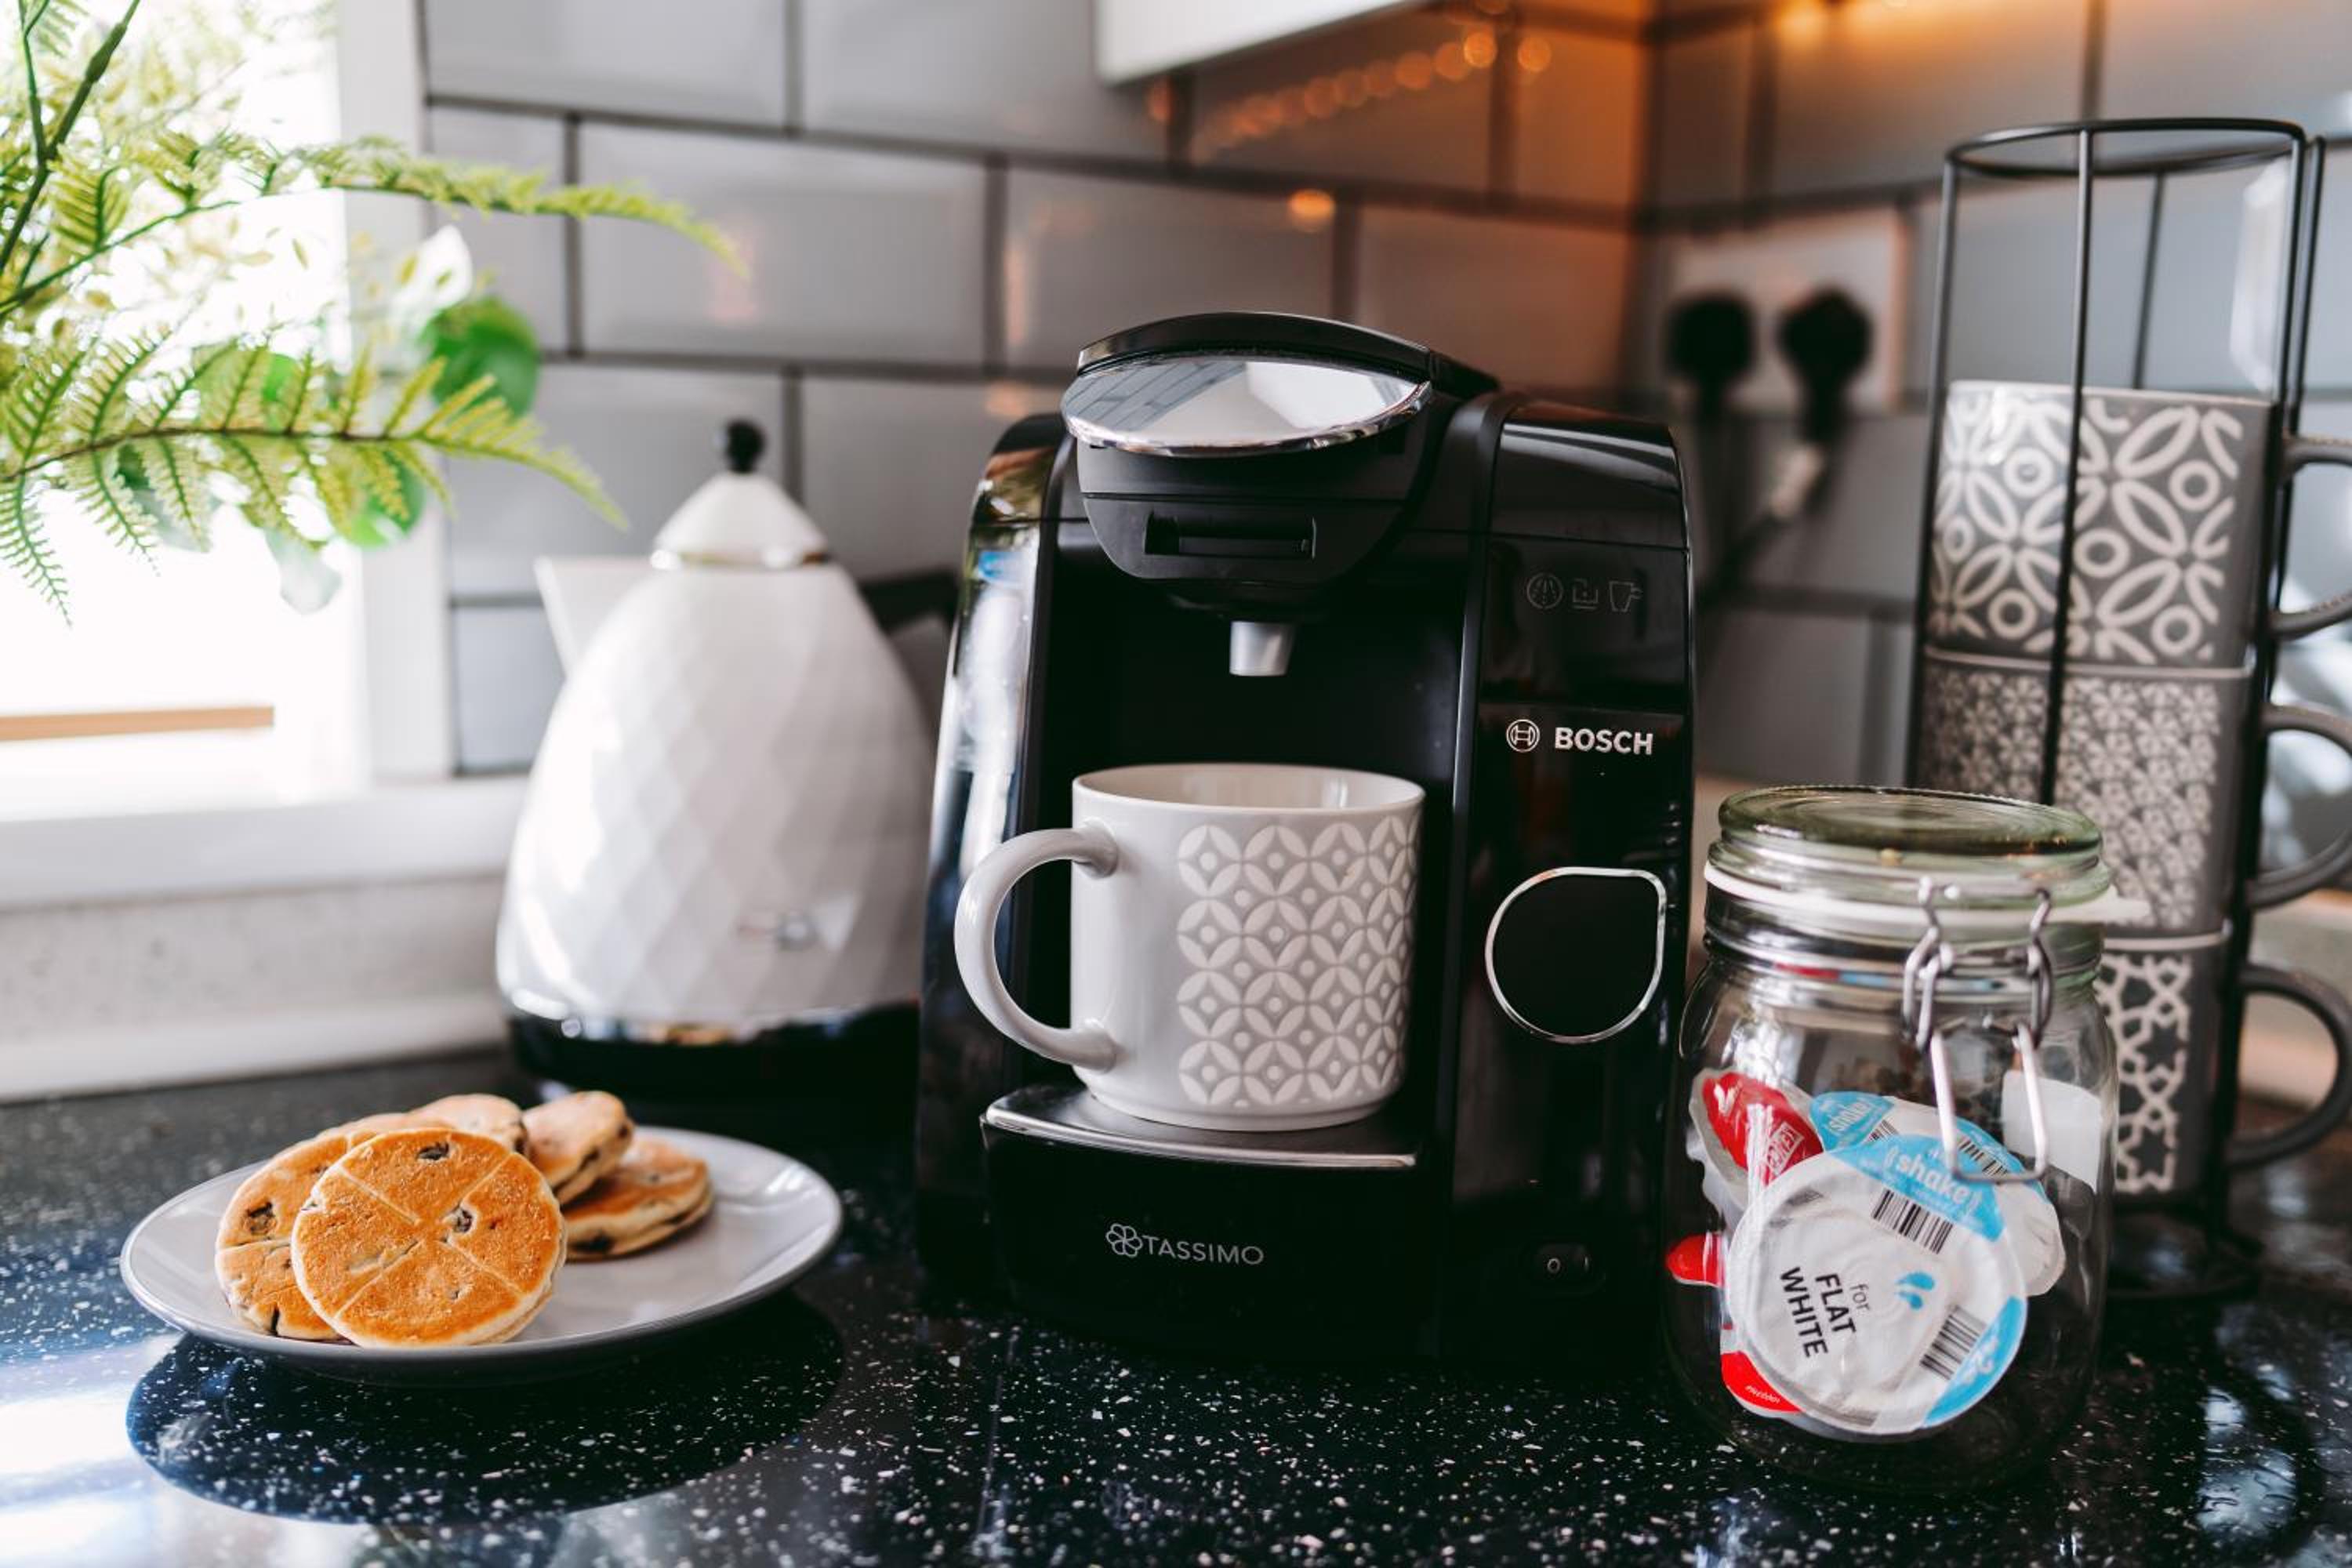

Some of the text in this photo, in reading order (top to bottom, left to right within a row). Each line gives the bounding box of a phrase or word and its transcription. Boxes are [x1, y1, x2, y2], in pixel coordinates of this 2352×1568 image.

[1555, 726, 1653, 755] BOSCH
[1896, 1152, 1971, 1205] shake
[1142, 1235, 1265, 1265] TASSIMO
[1780, 1266, 1828, 1358] WHITE
[1815, 1273, 1857, 1333] FLAT
[1849, 1283, 1871, 1310] for
